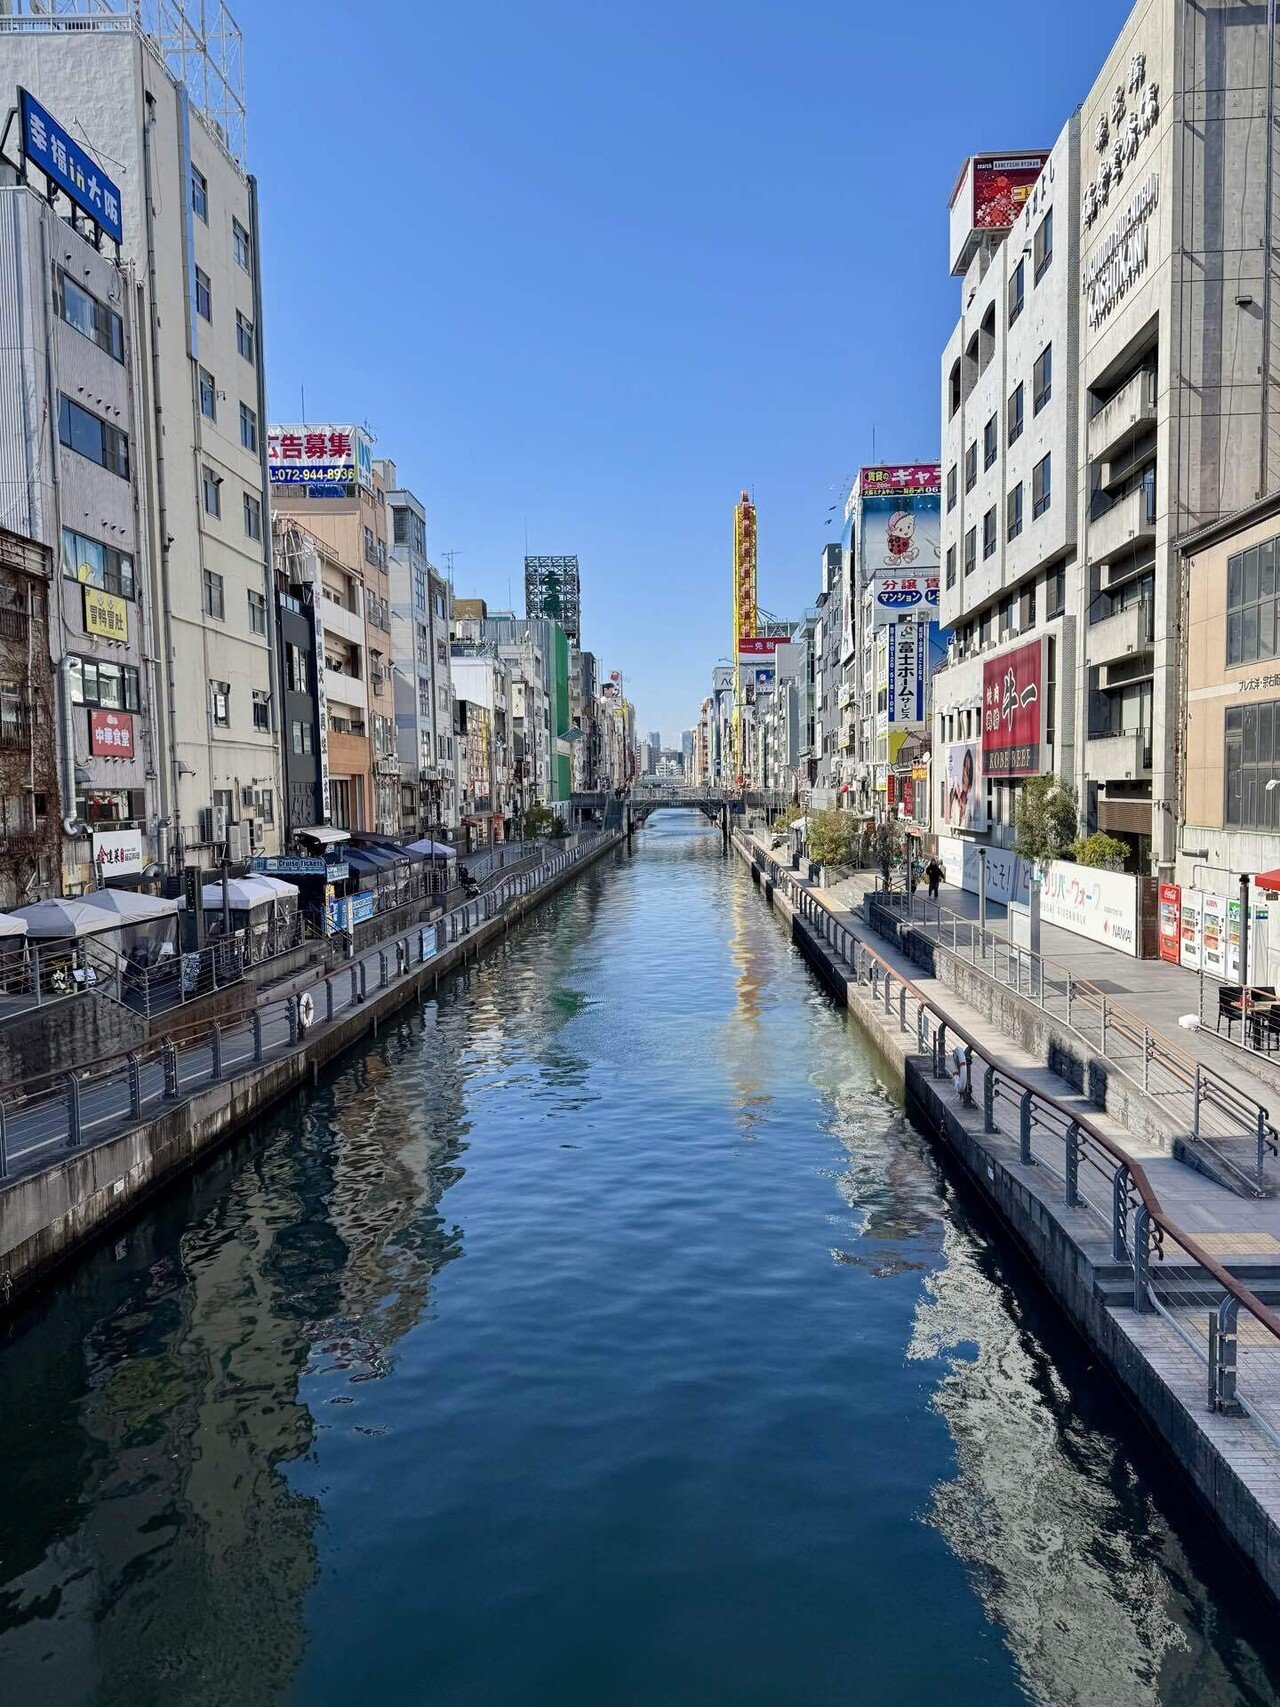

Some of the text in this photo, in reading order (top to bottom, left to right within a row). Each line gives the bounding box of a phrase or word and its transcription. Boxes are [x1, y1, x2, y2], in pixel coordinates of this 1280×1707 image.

[29, 112, 120, 227] 幸福in大阪
[882, 578, 917, 590] 分譲
[880, 592, 920, 602] マンション
[897, 641, 914, 720] 富士ホームサービス
[1002, 667, 1037, 732] 牛一
[95, 726, 130, 747] 中華食堂
[989, 748, 1031, 769] KOBE BEEF
[278, 859, 300, 868] Cruise
[301, 859, 324, 868] Tickets
[986, 858, 1011, 893] うこそ!
[1112, 923, 1133, 943] NANKAI
